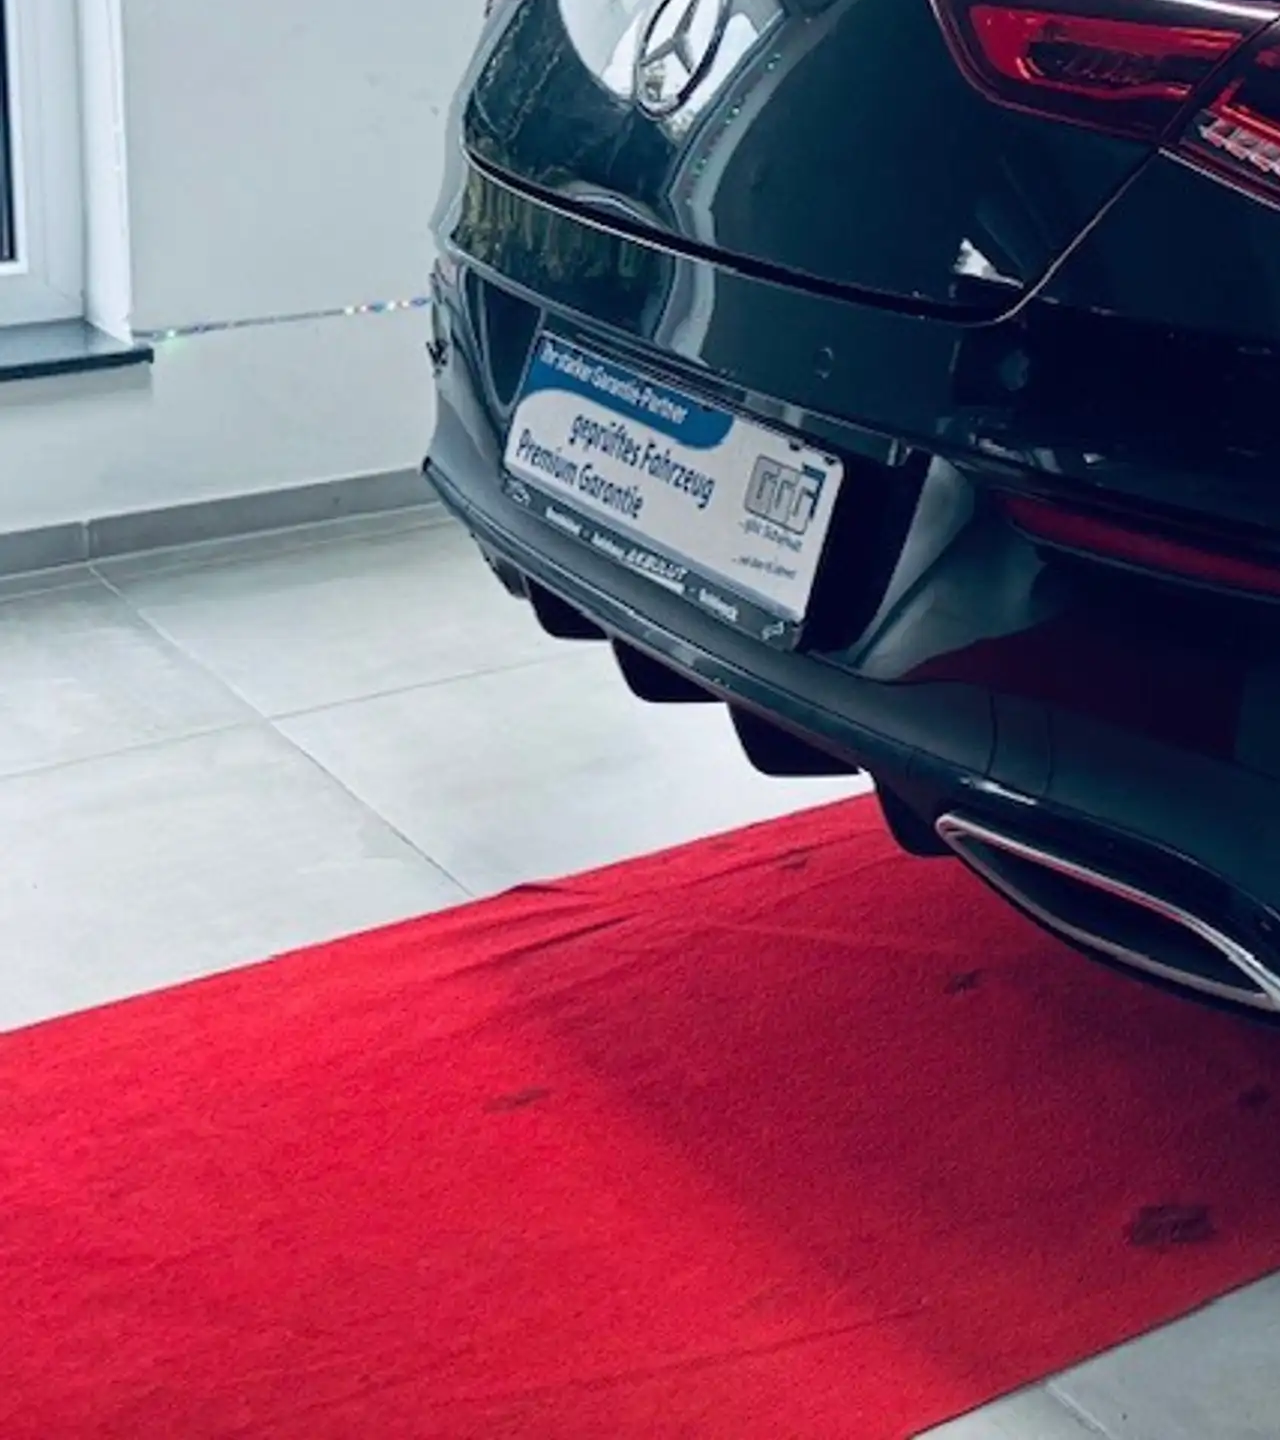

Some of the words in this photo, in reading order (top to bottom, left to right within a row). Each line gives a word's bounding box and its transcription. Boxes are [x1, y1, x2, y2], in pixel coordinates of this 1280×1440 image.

[516, 428, 576, 486] Premium
[578, 460, 645, 519] Garantie
[567, 413, 640, 467] geprüftes
[639, 437, 715, 510] Fahrzeug
